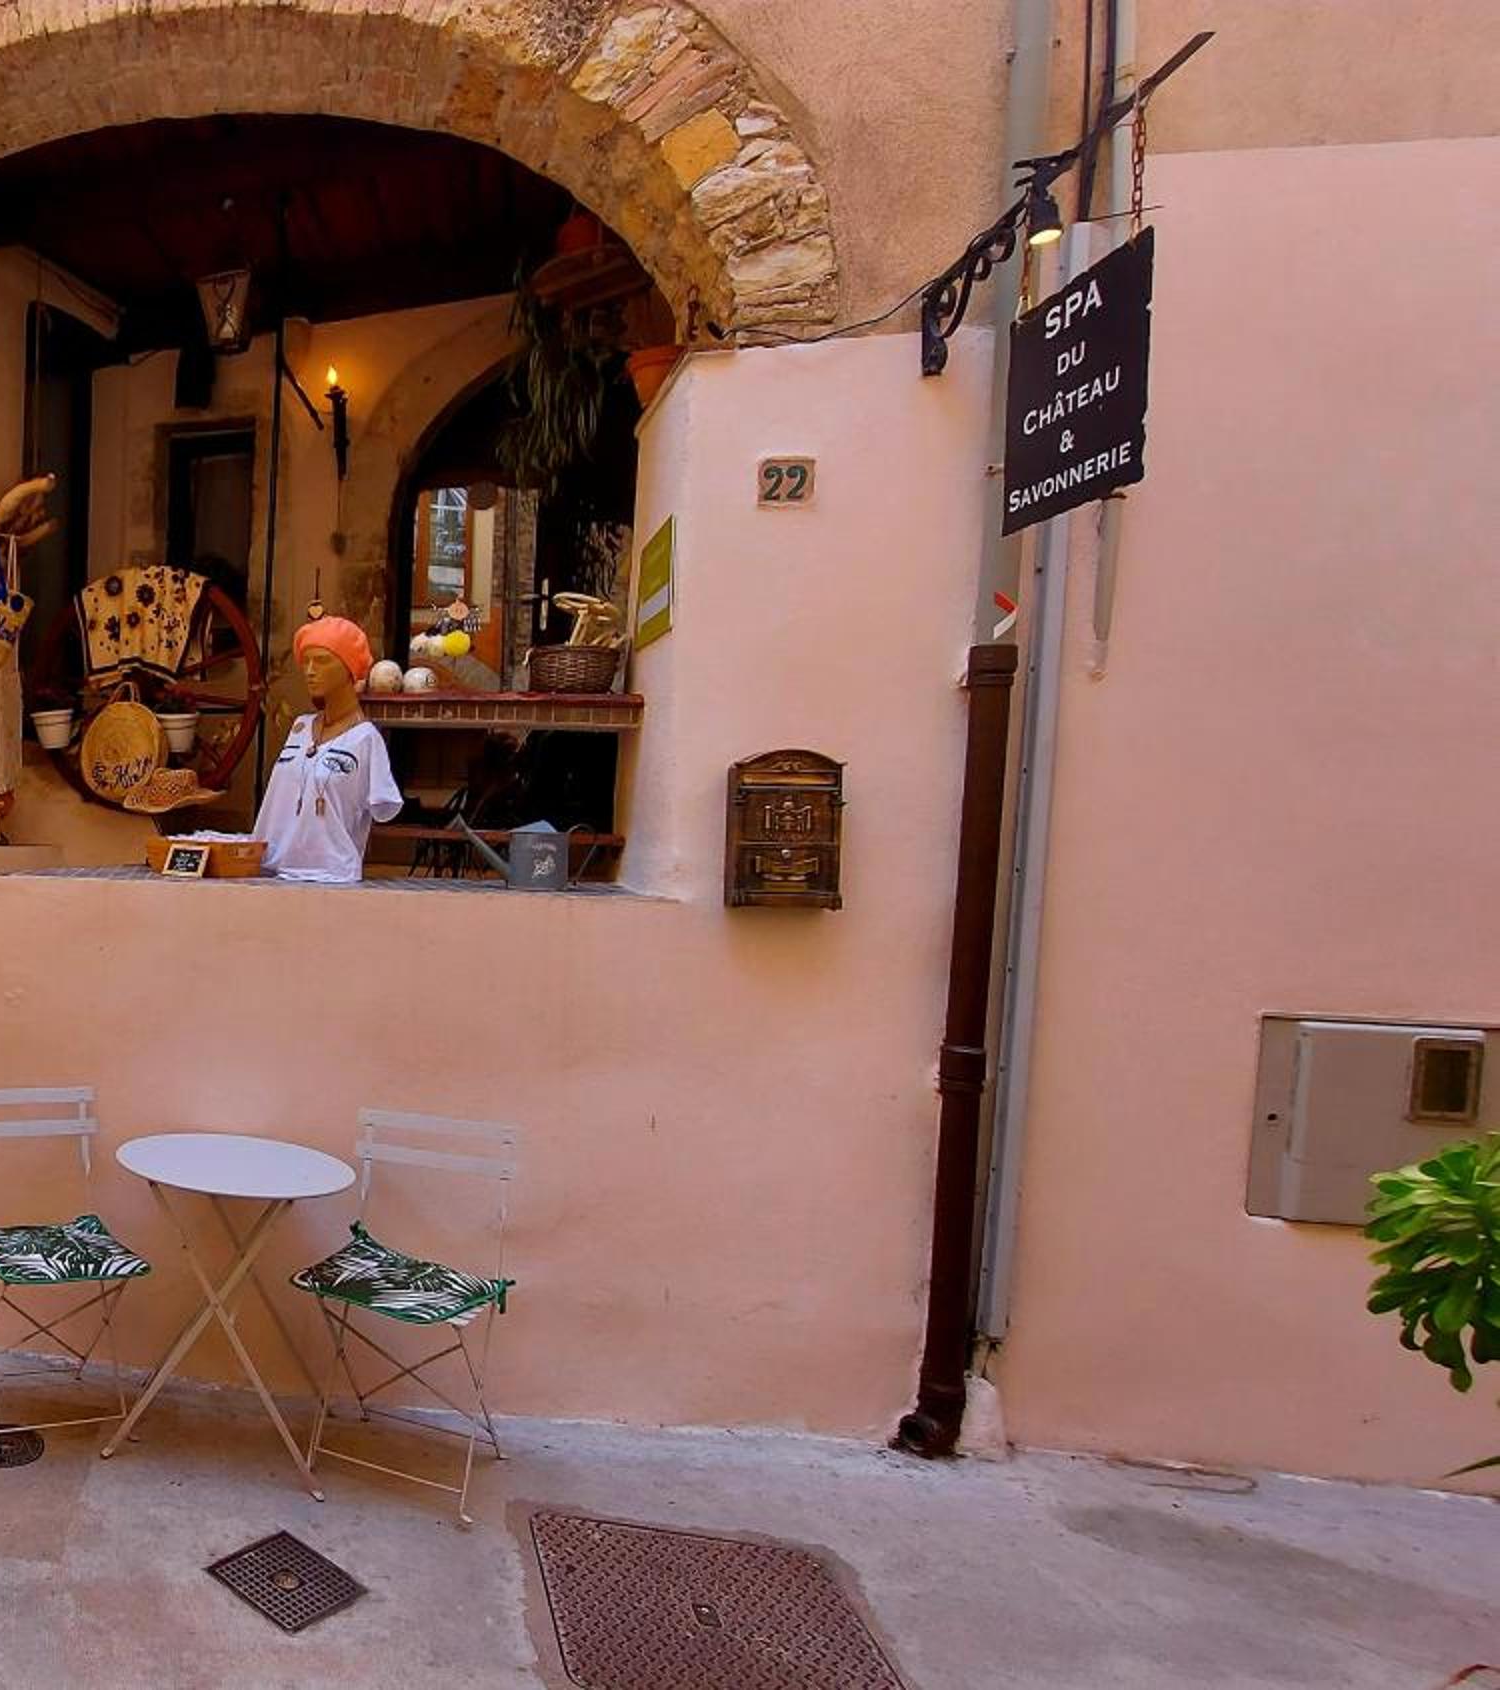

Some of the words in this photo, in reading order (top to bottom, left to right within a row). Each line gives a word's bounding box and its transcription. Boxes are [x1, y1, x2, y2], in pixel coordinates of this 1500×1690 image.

[1044, 279, 1103, 340] SPA
[1056, 341, 1086, 376] DU
[1022, 365, 1121, 436] CHÂTEAU
[1059, 428, 1075, 453] &
[763, 465, 808, 501] 22
[1008, 441, 1132, 513] SAVONNERIE
